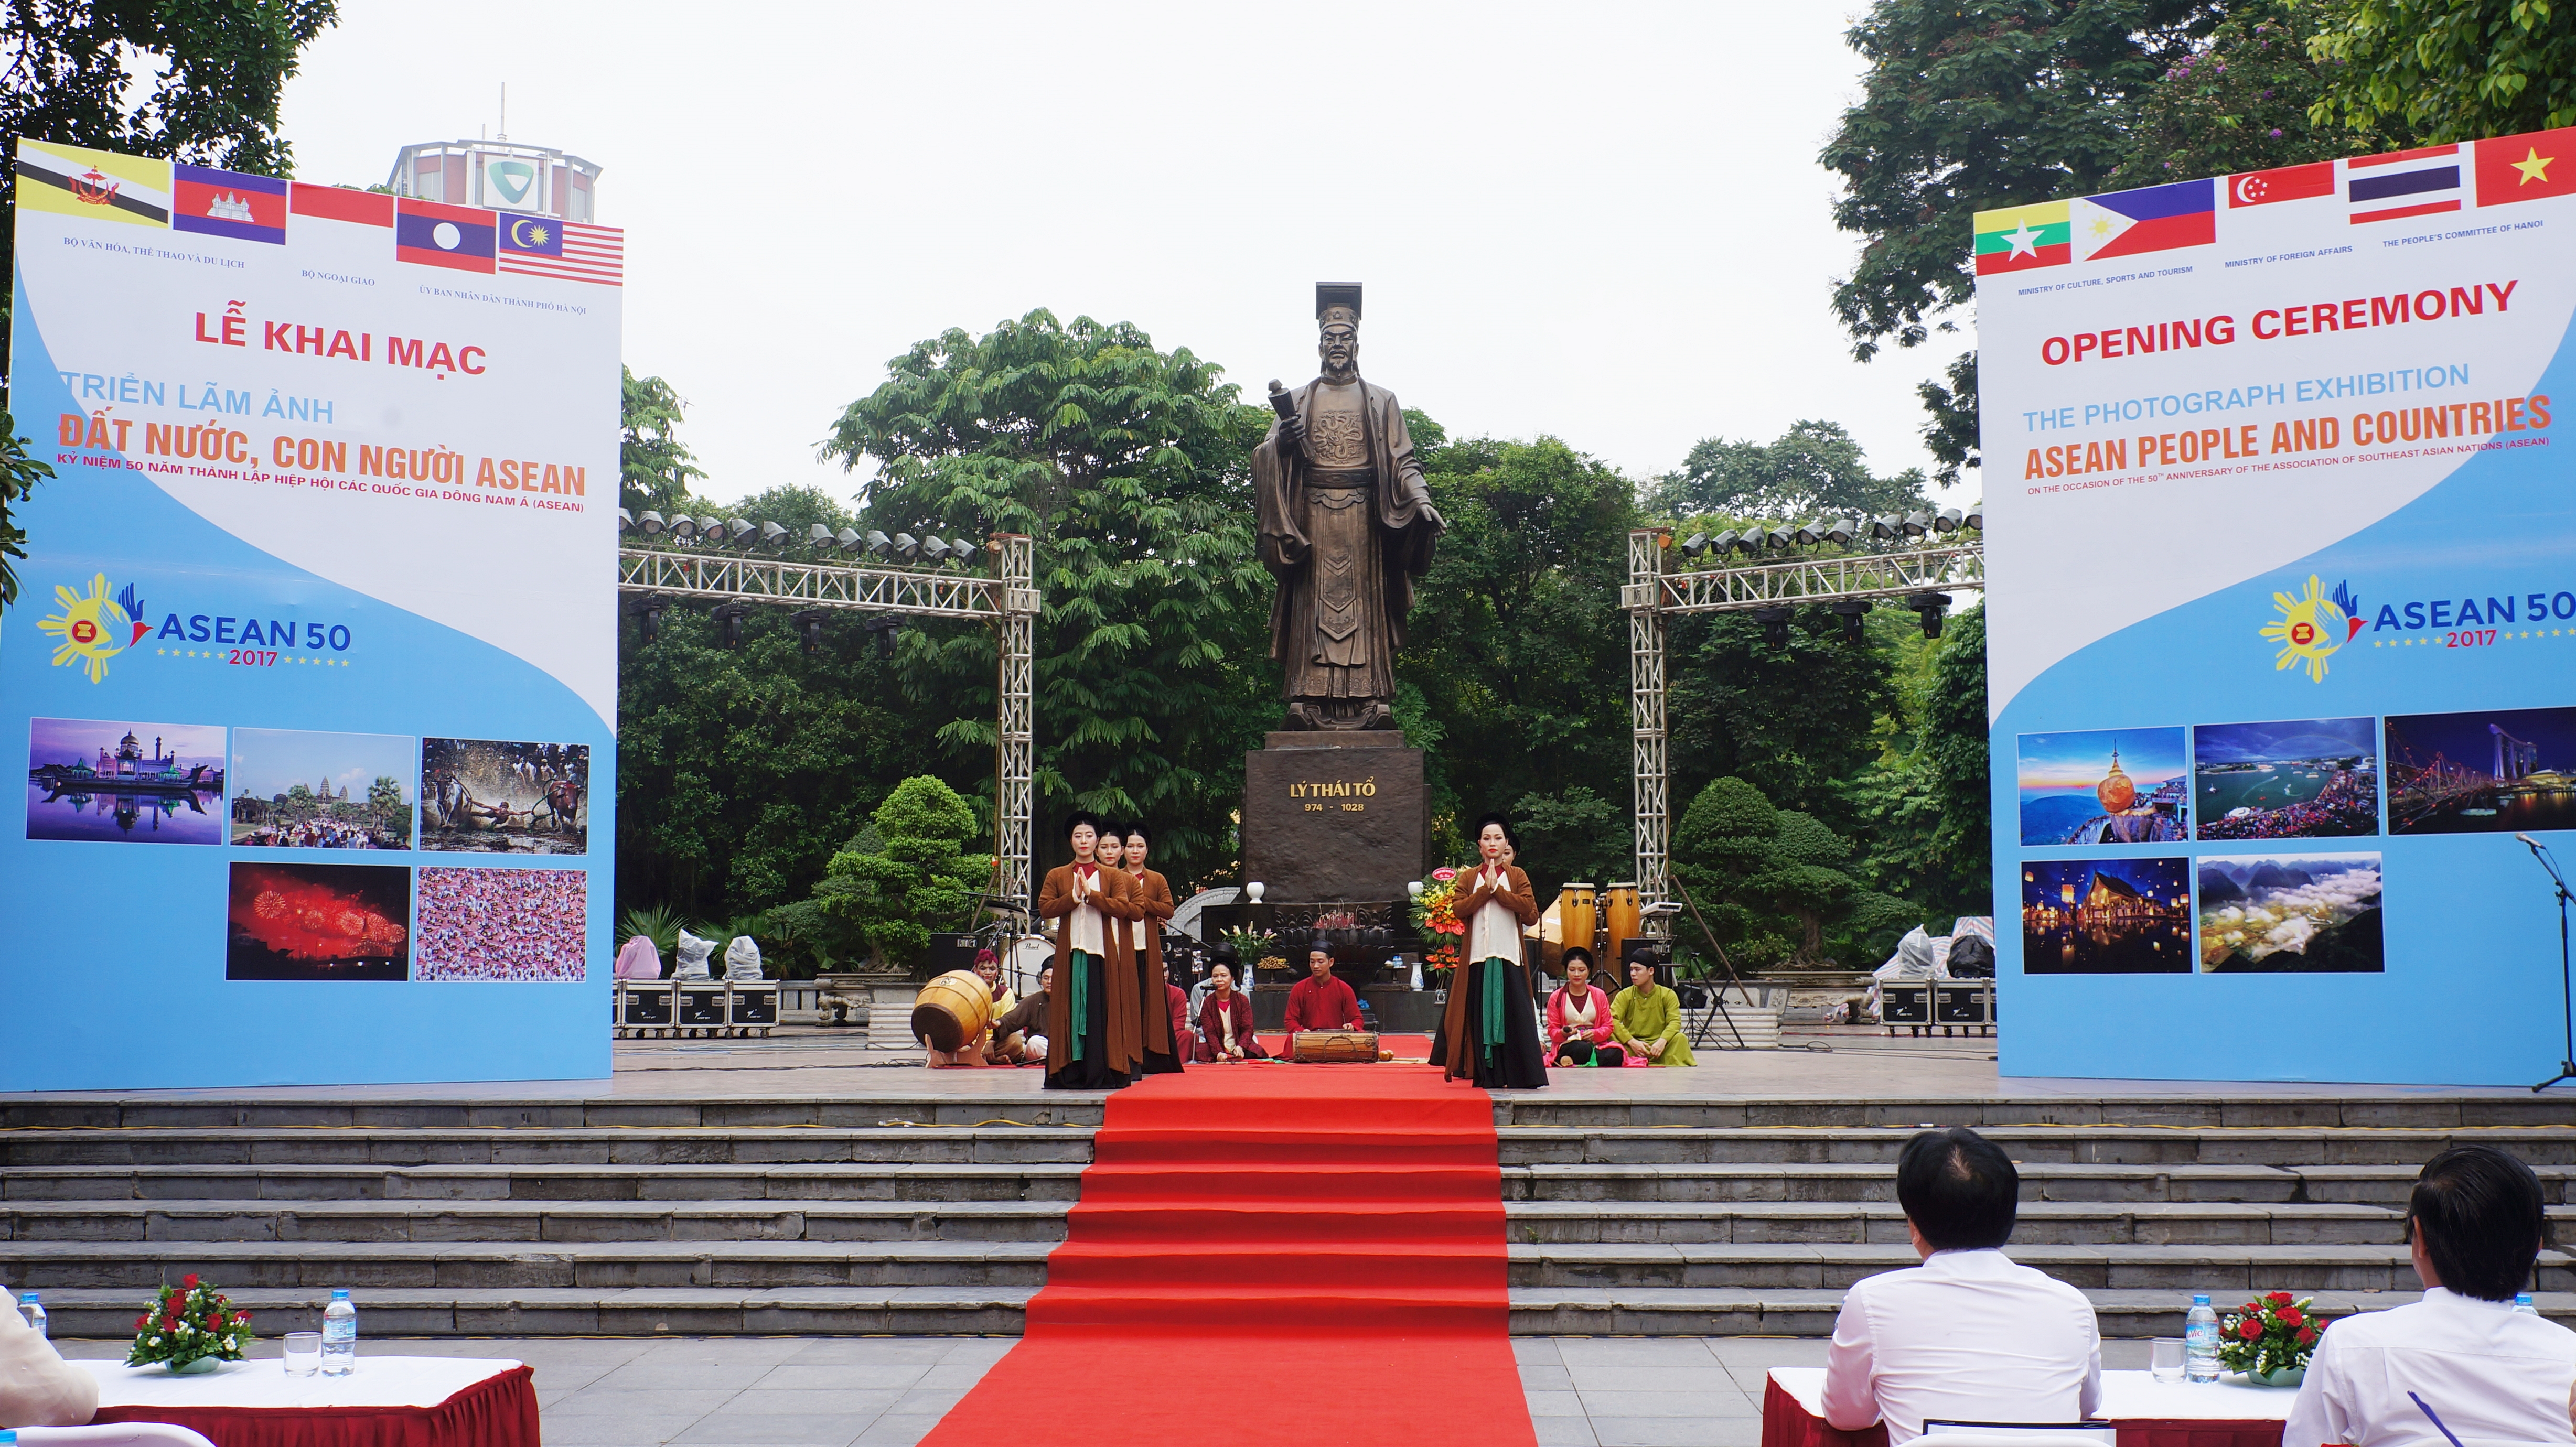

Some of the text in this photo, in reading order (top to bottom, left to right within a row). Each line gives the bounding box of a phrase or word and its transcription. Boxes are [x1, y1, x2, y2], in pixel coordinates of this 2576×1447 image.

[2382, 239, 2399, 247] THE
[2444, 226, 2497, 240] COMMITTEE
[2514, 220, 2543, 230] HANOI
[63, 237, 245, 268] BỘ VĂN HÓA, THỂ THAO VÀ DU LỊCH
[2224, 257, 2263, 268] MINISTRY
[2279, 251, 2315, 261] FOREIGN
[2317, 245, 2353, 256] AFFAIRS
[302, 269, 375, 286] BỘ NGOẠI GIAO
[2017, 285, 2053, 296] MINISTRY
[2067, 278, 2103, 289] CULTURE,
[2105, 274, 2136, 284] SPORTS
[2157, 266, 2193, 276] TOURISM
[420, 284, 587, 315] ỦY BAN NHÂN DÂN THÀNH PHỐ HÀ NỘI
[2041, 279, 2519, 366] OPENING CEREMONY
[196, 299, 486, 380] LỄ KHAI MẠC
[59, 371, 333, 424] TRIỂN LÃM ẢNH
[2022, 363, 2470, 432] THE PHOTOGRAPH EXHIBITION
[58, 406, 585, 496] ĐẤT NƯỚC, CON NGƯỜI ASEAN
[2024, 395, 2550, 480] ASEAN PEOPLE AND COUNTRIES
[56, 451, 584, 512] KỶ NIỆM 50 NĂM THÀNH LẬP HIỆP HỘI CÁC QUỐC GIA ĐÔNG NAM Á (ASEAN)
[2028, 487, 2041, 495] ON
[2063, 480, 2110, 491] OCCASION
[2166, 468, 2232, 480] ANNIVERSARY
[2272, 458, 2339, 469] ASSOCIATION
[2358, 449, 2419, 462] SOUTHEAST
[2422, 447, 2454, 456] ASIAN
[2456, 441, 2503, 452] NATIONS
[2506, 437, 2550, 449] (ASEAN)
[2373, 591, 2576, 632] ASEAN 50
[157, 613, 351, 651] ASEAN 50
[2446, 630, 2497, 649] 2017
[229, 649, 278, 666] 2017
[1290, 776, 1376, 797] LÝ THÁI TỔ
[1304, 803, 1323, 812] 974
[1341, 803, 1365, 812] 1028
[1023, 942, 1040, 951] Pearl
